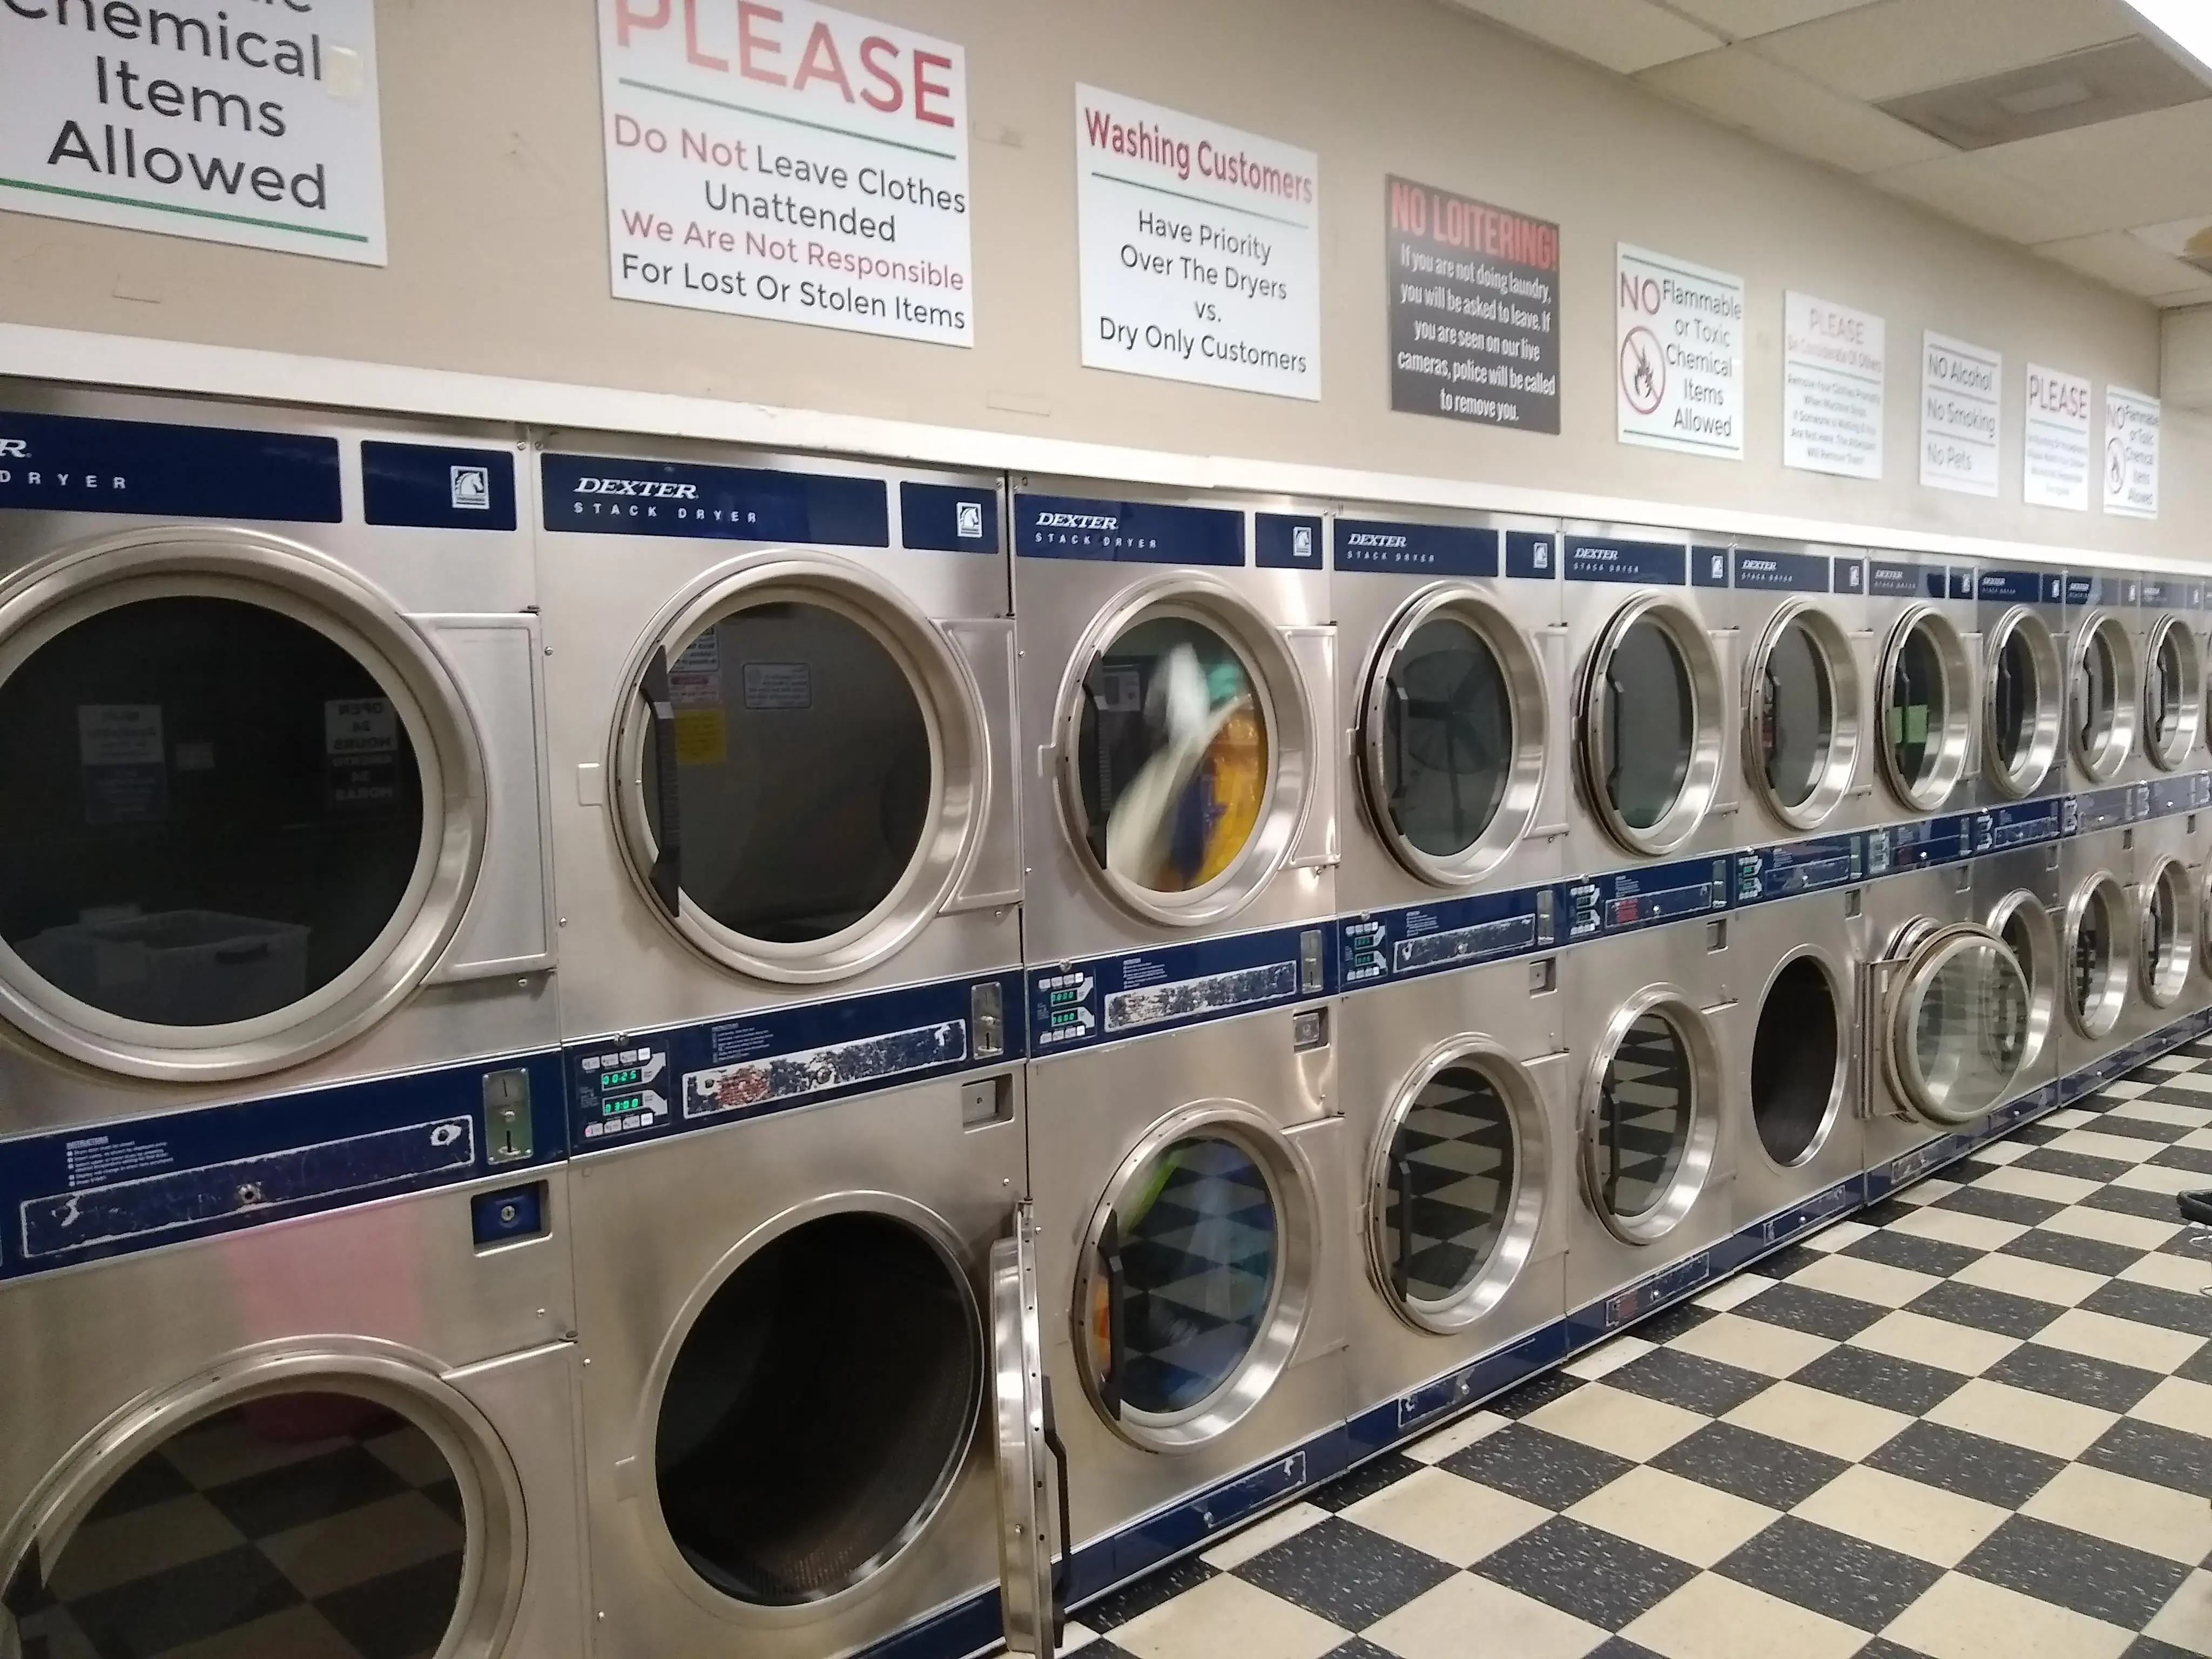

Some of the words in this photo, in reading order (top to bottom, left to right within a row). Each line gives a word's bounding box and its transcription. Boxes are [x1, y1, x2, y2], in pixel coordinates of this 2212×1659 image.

[616, 0, 955, 127] PLEASE
[96, 55, 287, 138] Items
[46, 119, 327, 210] Allowed
[615, 113, 667, 153] Do
[682, 129, 748, 171] Not
[757, 145, 848, 189] Leave
[858, 167, 966, 213] Clothes
[1085, 107, 1191, 180] Washing
[1197, 140, 1312, 204] Customers
[704, 179, 896, 242] Unattended
[1391, 182, 1426, 235] NO
[1432, 195, 1558, 269] LOITERING!
[621, 208, 674, 241] We
[683, 221, 736, 252] Are
[746, 231, 798, 262] Not
[808, 242, 965, 290] Responsible
[1138, 210, 1192, 242] Have
[1200, 224, 1272, 266] Priority
[622, 252, 674, 285] For
[684, 262, 747, 297] Lost
[757, 275, 791, 302] Or
[800, 282, 886, 317] Stolen
[895, 295, 966, 329] Items
[1121, 244, 1173, 275] Over
[1179, 256, 1218, 285] The
[1225, 266, 1287, 299] Dryers
[1401, 243, 1413, 266] If
[1412, 250, 1434, 272] you
[1435, 258, 1455, 278] are
[1456, 262, 1475, 283] not
[1477, 264, 1508, 295] doing
[1509, 272, 1552, 304] laundry,
[1195, 300, 1222, 322] vs.
[1400, 284, 1422, 304] you
[1424, 285, 1446, 309] will
[1447, 289, 1462, 311] be
[1462, 296, 1497, 320] asked
[1498, 304, 1510, 324] to
[1511, 304, 1541, 330] leave.
[1542, 311, 1551, 333] If
[1620, 271, 1661, 315] NO
[1663, 279, 1742, 320] Flammable
[1100, 316, 1138, 350] Dry
[1145, 325, 1194, 359] Only
[1201, 335, 1306, 373] Customers
[1414, 320, 1435, 341] you
[1437, 325, 1457, 345] are
[1457, 331, 1485, 350] seen
[1486, 335, 1500, 353] on
[1502, 338, 1520, 356] our
[1521, 338, 1540, 362] live
[1675, 319, 1690, 337] or
[1694, 318, 1730, 347] Toxic
[1810, 308, 1864, 346] PLEASE
[1398, 351, 1451, 380] cameras,
[1452, 359, 1488, 383] police
[1488, 365, 1509, 386] will
[1510, 368, 1523, 390] be
[1523, 372, 1555, 396] called
[1666, 342, 1732, 377] Chemical
[1928, 353, 1947, 378] NO
[1951, 361, 1992, 391] Alcohol
[1439, 388, 1453, 411] to
[1455, 395, 1497, 416] remove
[1496, 401, 1519, 422] you.
[1684, 378, 1724, 406] Items
[2029, 375, 2087, 419] PLEASE
[1674, 406, 1732, 436] Allowed
[1927, 398, 1945, 421] No
[1947, 401, 1995, 439] Smoking
[2107, 404, 2125, 430] NO
[1927, 443, 1944, 466] No
[1947, 445, 1972, 470] Pets
[0, 470, 126, 489] DRYER
[573, 477, 697, 500] DEXTER
[574, 502, 657, 517] STACK
[678, 508, 757, 523] DRYER
[1036, 512, 1117, 530] DEXTER
[1035, 532, 1090, 545] STACK
[1103, 537, 1157, 549] DRYER
[1348, 534, 1407, 548] DEXTER
[1574, 548, 1618, 561] DEXTER
[1742, 559, 1777, 571] DEXTER
